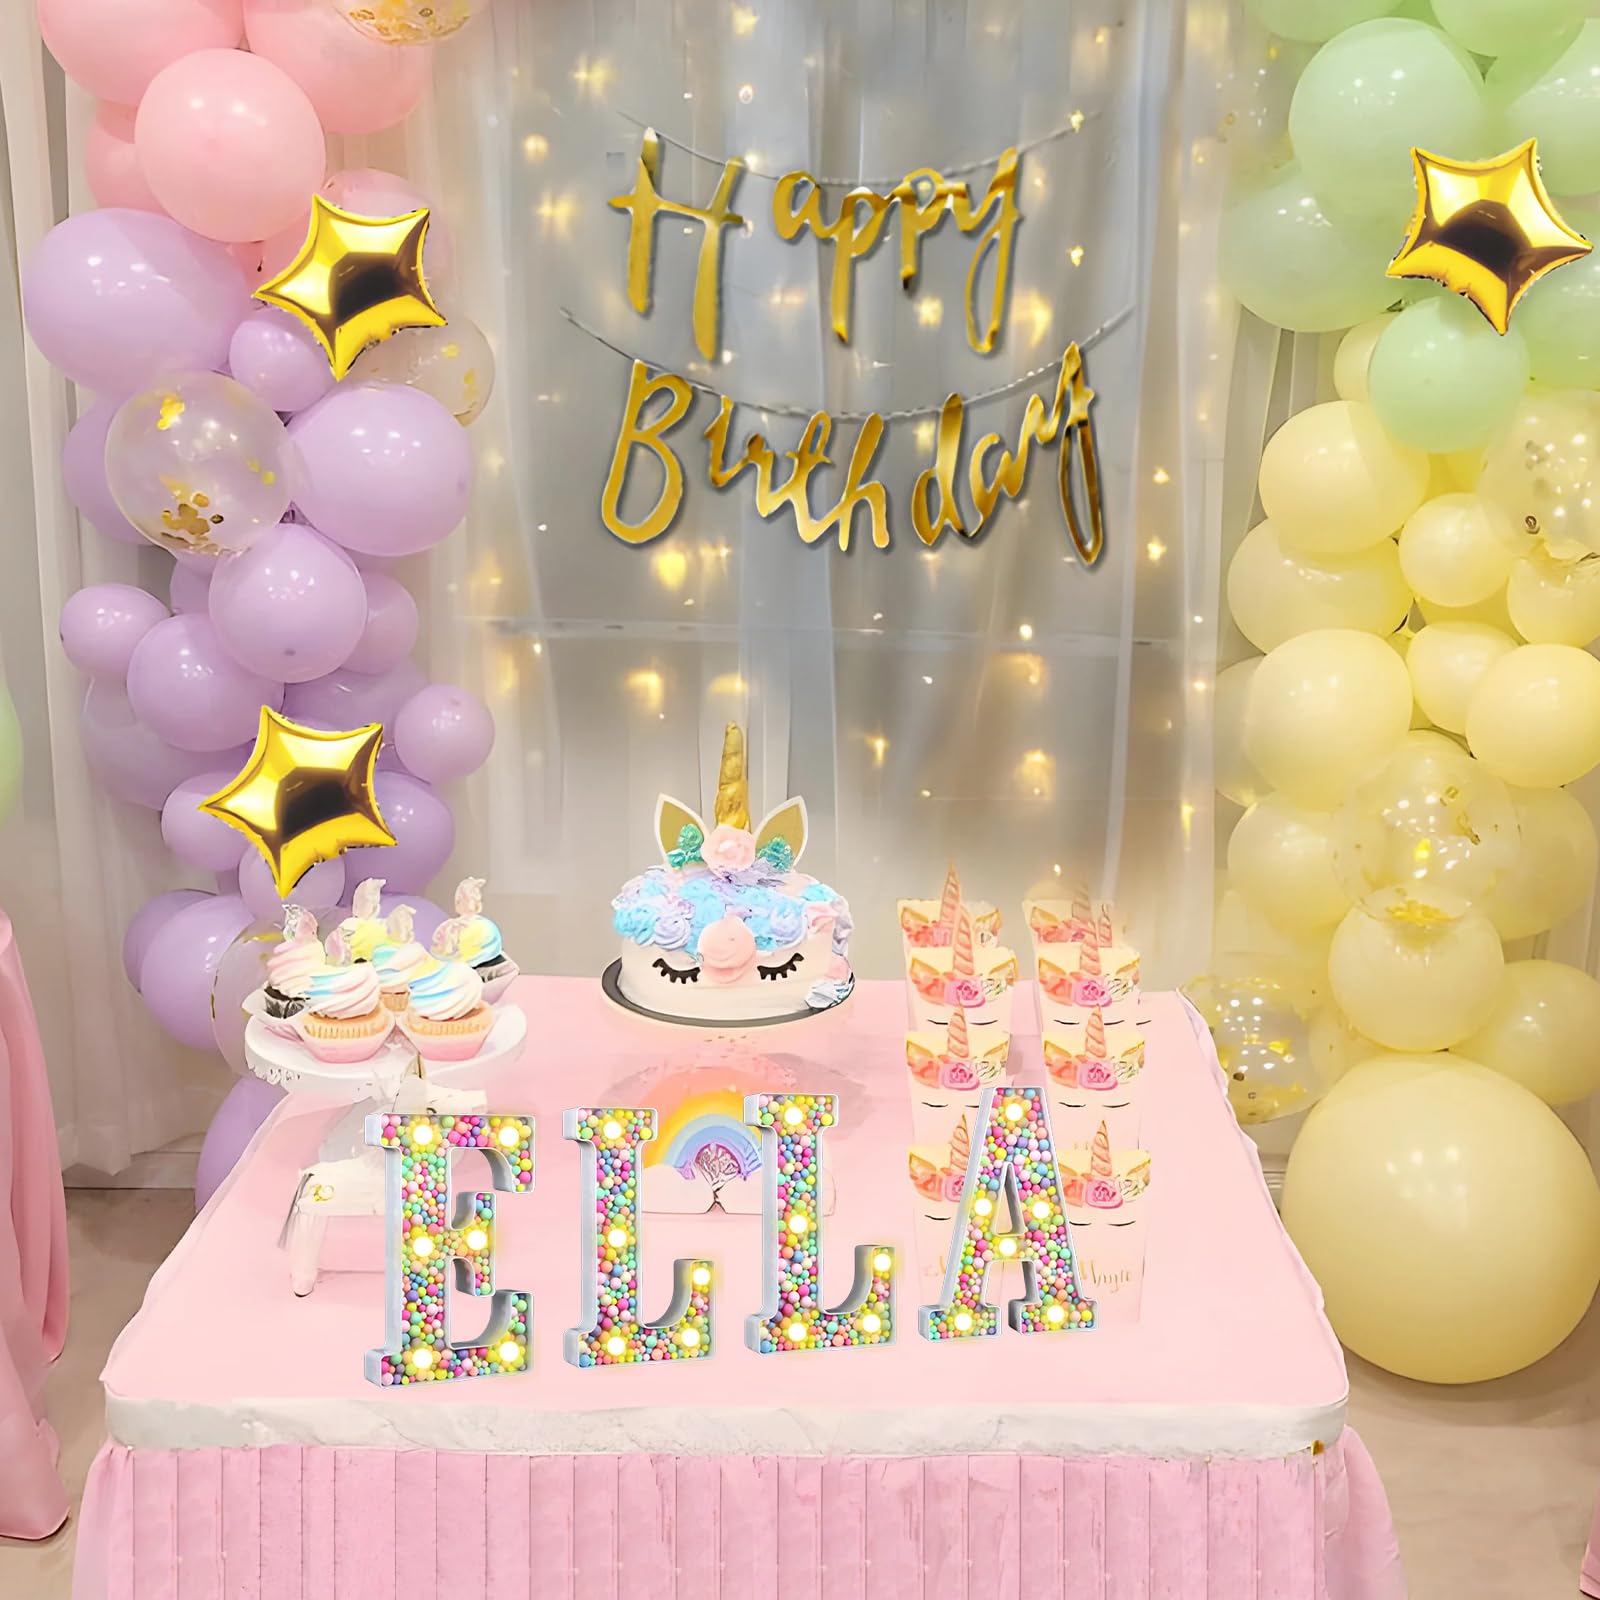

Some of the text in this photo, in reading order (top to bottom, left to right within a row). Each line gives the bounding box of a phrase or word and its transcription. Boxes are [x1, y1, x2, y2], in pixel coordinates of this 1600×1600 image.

[608, 127, 1023, 359] Happy
[602, 342, 1104, 563] Birthday
[364, 1087, 1098, 1387] ELLA
